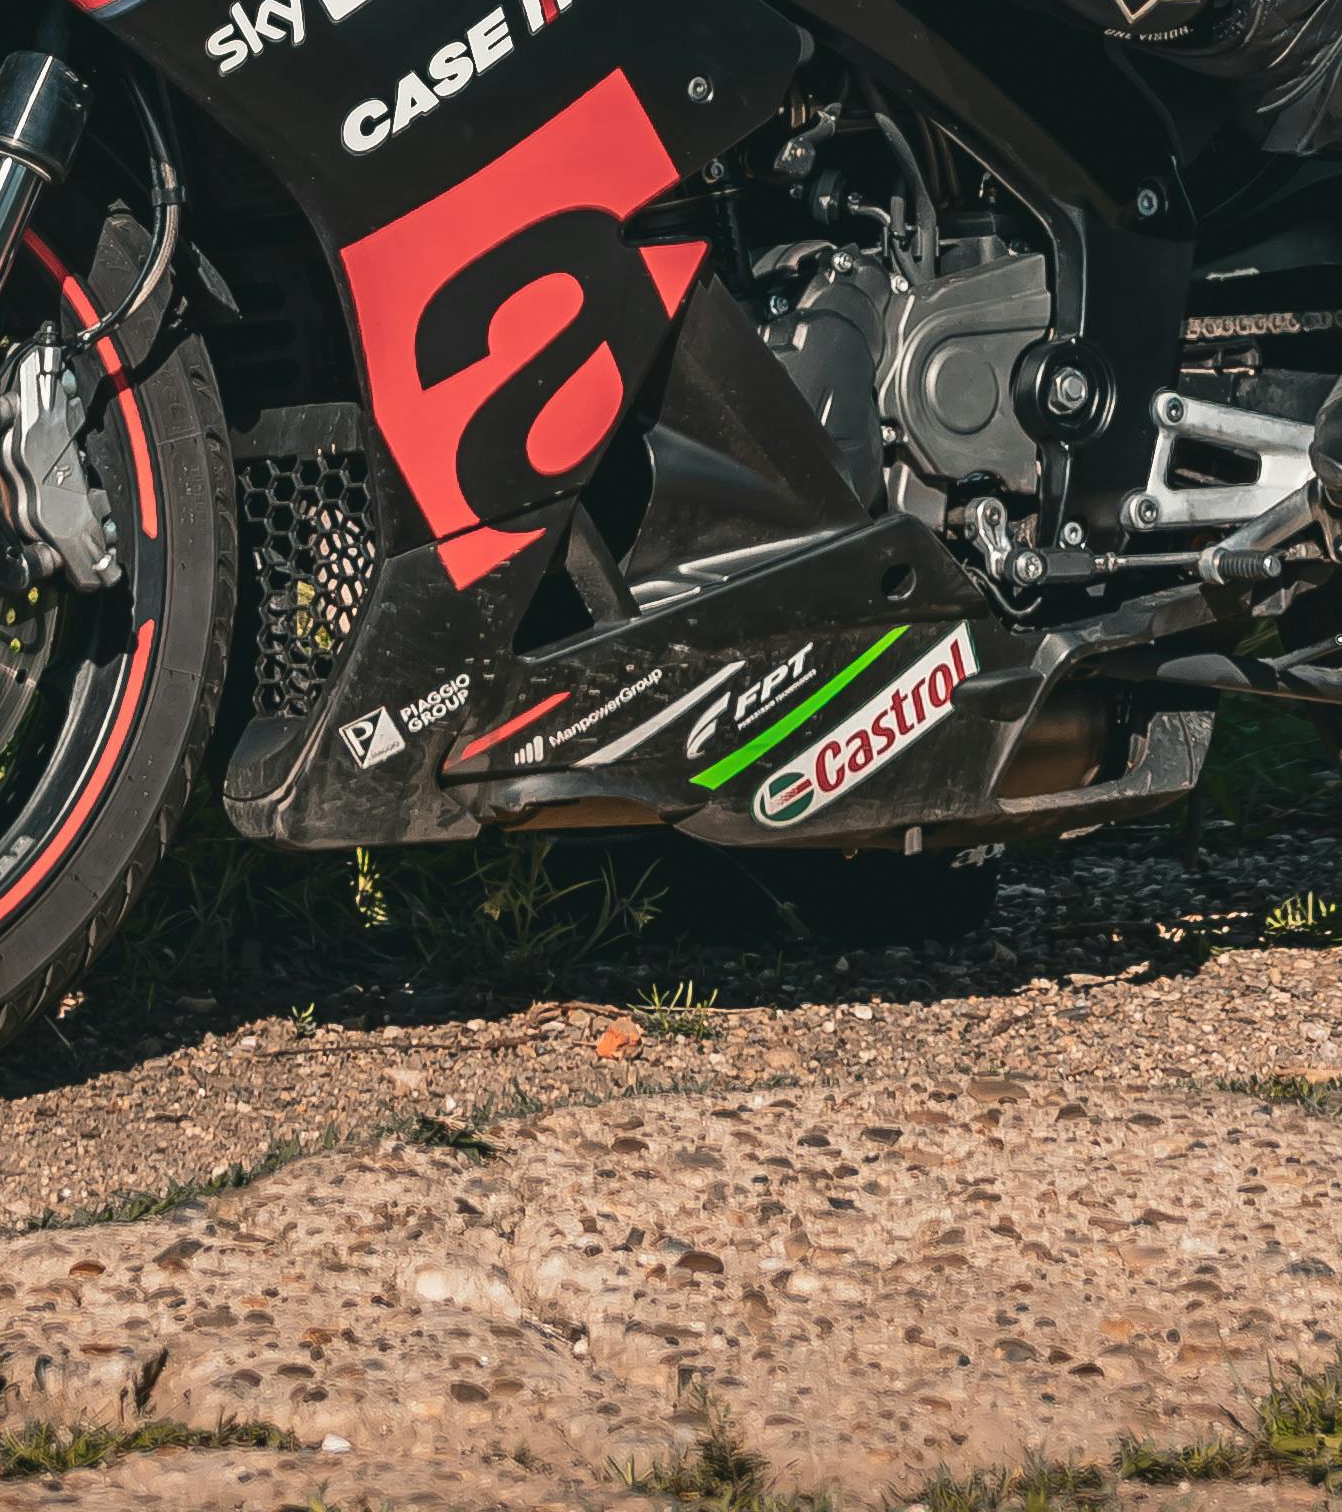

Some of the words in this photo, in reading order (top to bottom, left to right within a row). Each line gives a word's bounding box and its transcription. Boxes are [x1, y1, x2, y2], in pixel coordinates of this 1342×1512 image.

[341, 5, 515, 156] CASE
[399, 673, 471, 722] PIAGGIO
[408, 689, 470, 734] GROUP
[548, 667, 664, 748] ManpowerGroup
[734, 641, 815, 722] FPT
[815, 637, 968, 793] Castrol
